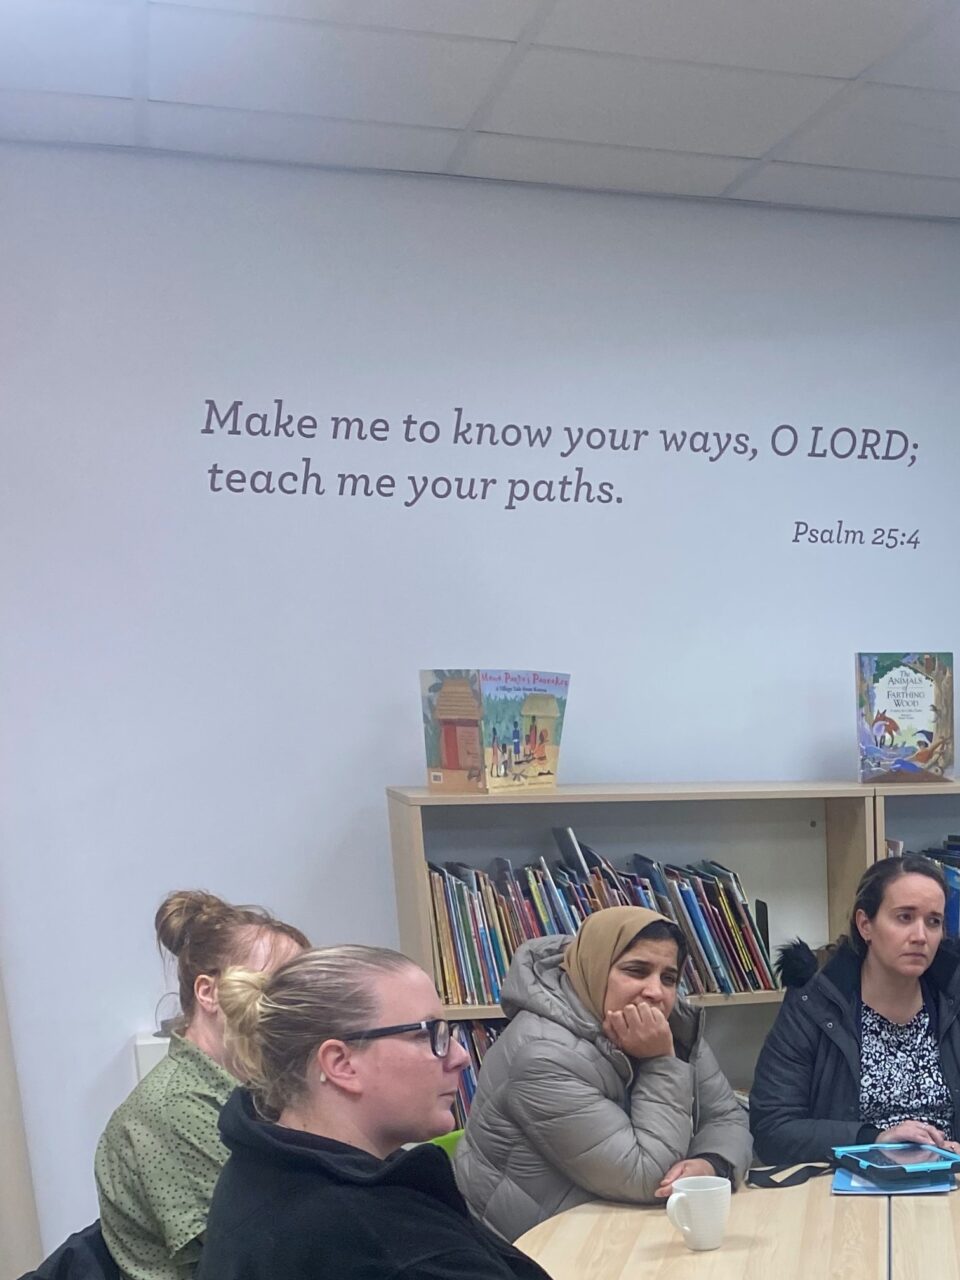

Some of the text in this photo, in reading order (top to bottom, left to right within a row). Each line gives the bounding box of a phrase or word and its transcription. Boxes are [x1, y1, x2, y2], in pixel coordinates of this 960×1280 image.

[200, 398, 919, 468] Make me to know your ways, O LORD;
[207, 456, 623, 511] teach me your paths.
[791, 519, 921, 550] Psalm 25:4
